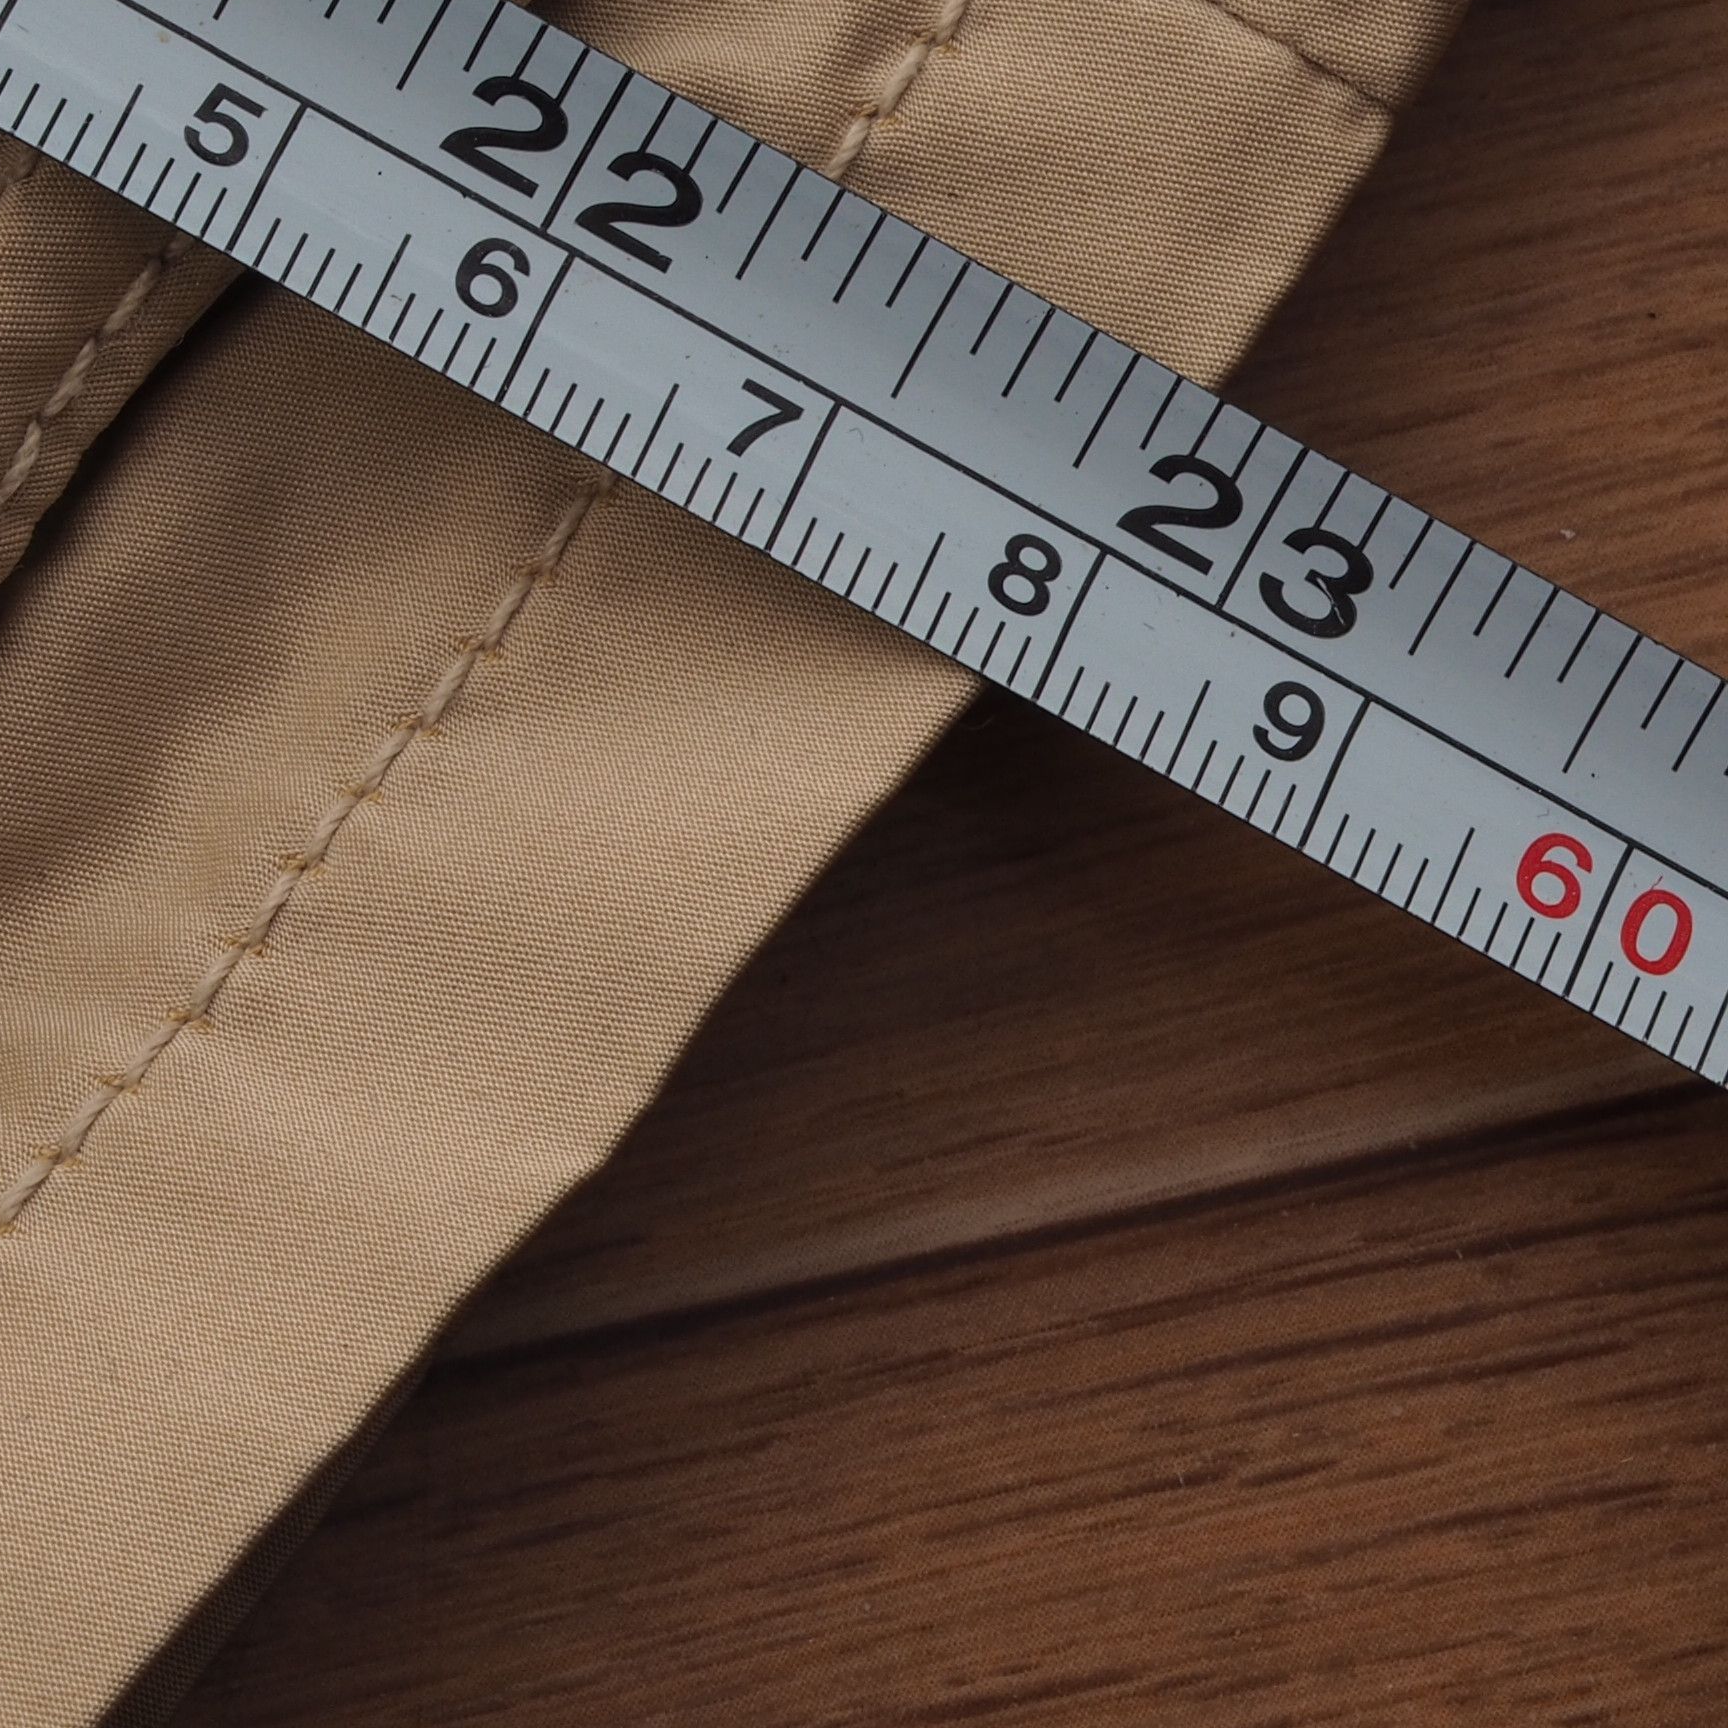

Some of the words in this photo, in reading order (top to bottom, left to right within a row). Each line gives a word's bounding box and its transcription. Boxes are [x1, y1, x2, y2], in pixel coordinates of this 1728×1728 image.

[184, 83, 267, 167] 5
[455, 238, 531, 318] 6
[726, 379, 804, 457] 7
[987, 533, 1062, 616] 8
[1252, 681, 1325, 761] 9
[1516, 833, 1693, 975] 60
[440, 76, 703, 273] 22
[1116, 454, 1374, 639] 23
